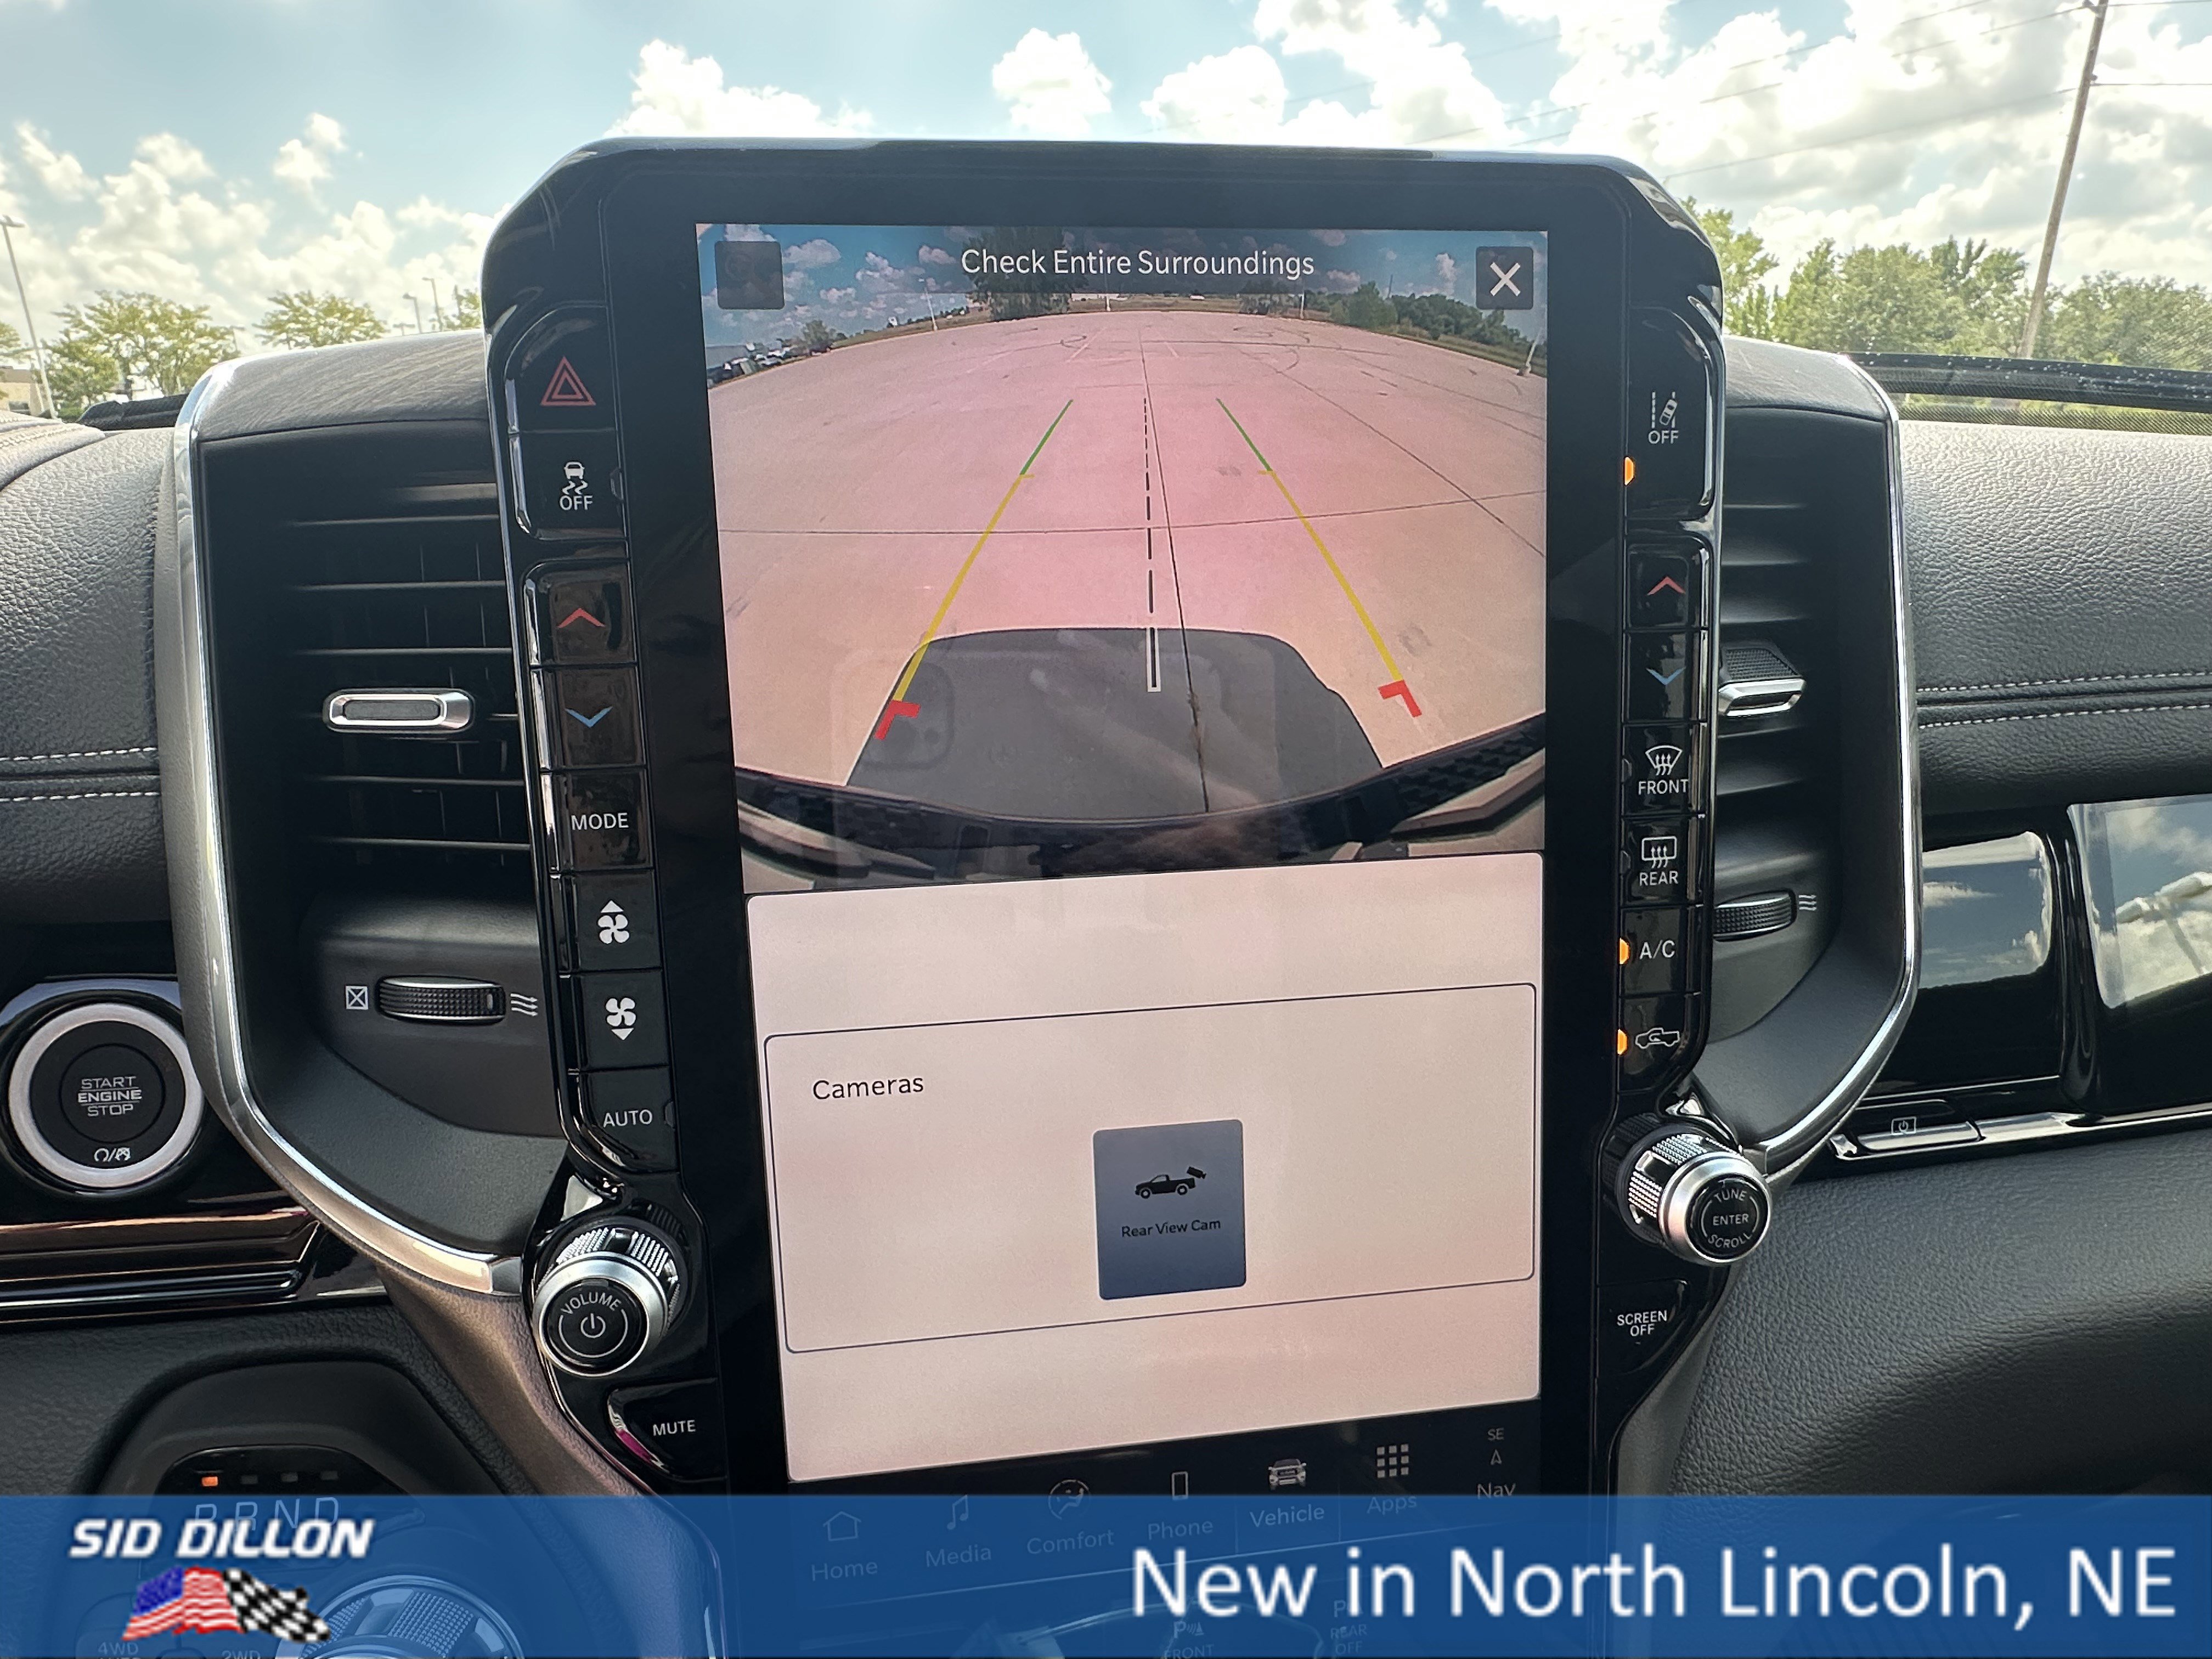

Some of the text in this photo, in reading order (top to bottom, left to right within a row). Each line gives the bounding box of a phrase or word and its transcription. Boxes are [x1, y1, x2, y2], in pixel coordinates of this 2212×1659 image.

[961, 249, 1314, 280] Check Entire Surroundings
[1647, 430, 1679, 445] OFF
[559, 495, 593, 511] OFF
[1638, 778, 1689, 795] FRONT
[571, 812, 629, 831] MODE
[1639, 870, 1679, 887] REAR
[1639, 939, 1677, 960] A/C
[81, 1075, 137, 1090] START
[812, 1074, 925, 1101] Cameras
[77, 1090, 143, 1104] ENGINE
[87, 1104, 134, 1117] STOP
[602, 1109, 653, 1127] AUTO
[1713, 1189, 1747, 1204] TUNE
[1121, 1217, 1222, 1238] Rear View Cam
[1712, 1213, 1750, 1226] ENTER
[1707, 1232, 1753, 1249] SCROLL
[560, 1291, 623, 1316] VOLUME
[1617, 1310, 1668, 1326] SCREEN
[1629, 1323, 1655, 1337] OFF
[652, 1419, 697, 1436] MUTE
[1486, 1427, 1505, 1441] SE
[1476, 1482, 1516, 1500] Nav
[1366, 1494, 1419, 1516] Apps
[1248, 1503, 1325, 1528] Vehicle
[1147, 1519, 1214, 1541] Phone
[1026, 1528, 1116, 1555] Comfort
[926, 1543, 992, 1568] Media
[810, 1559, 878, 1582] Home
[1330, 1623, 1368, 1640] REAR
[98, 1641, 139, 1656] 4WD
[1163, 1644, 1214, 1658] FRONT
[1334, 1640, 1363, 1656] OFF
